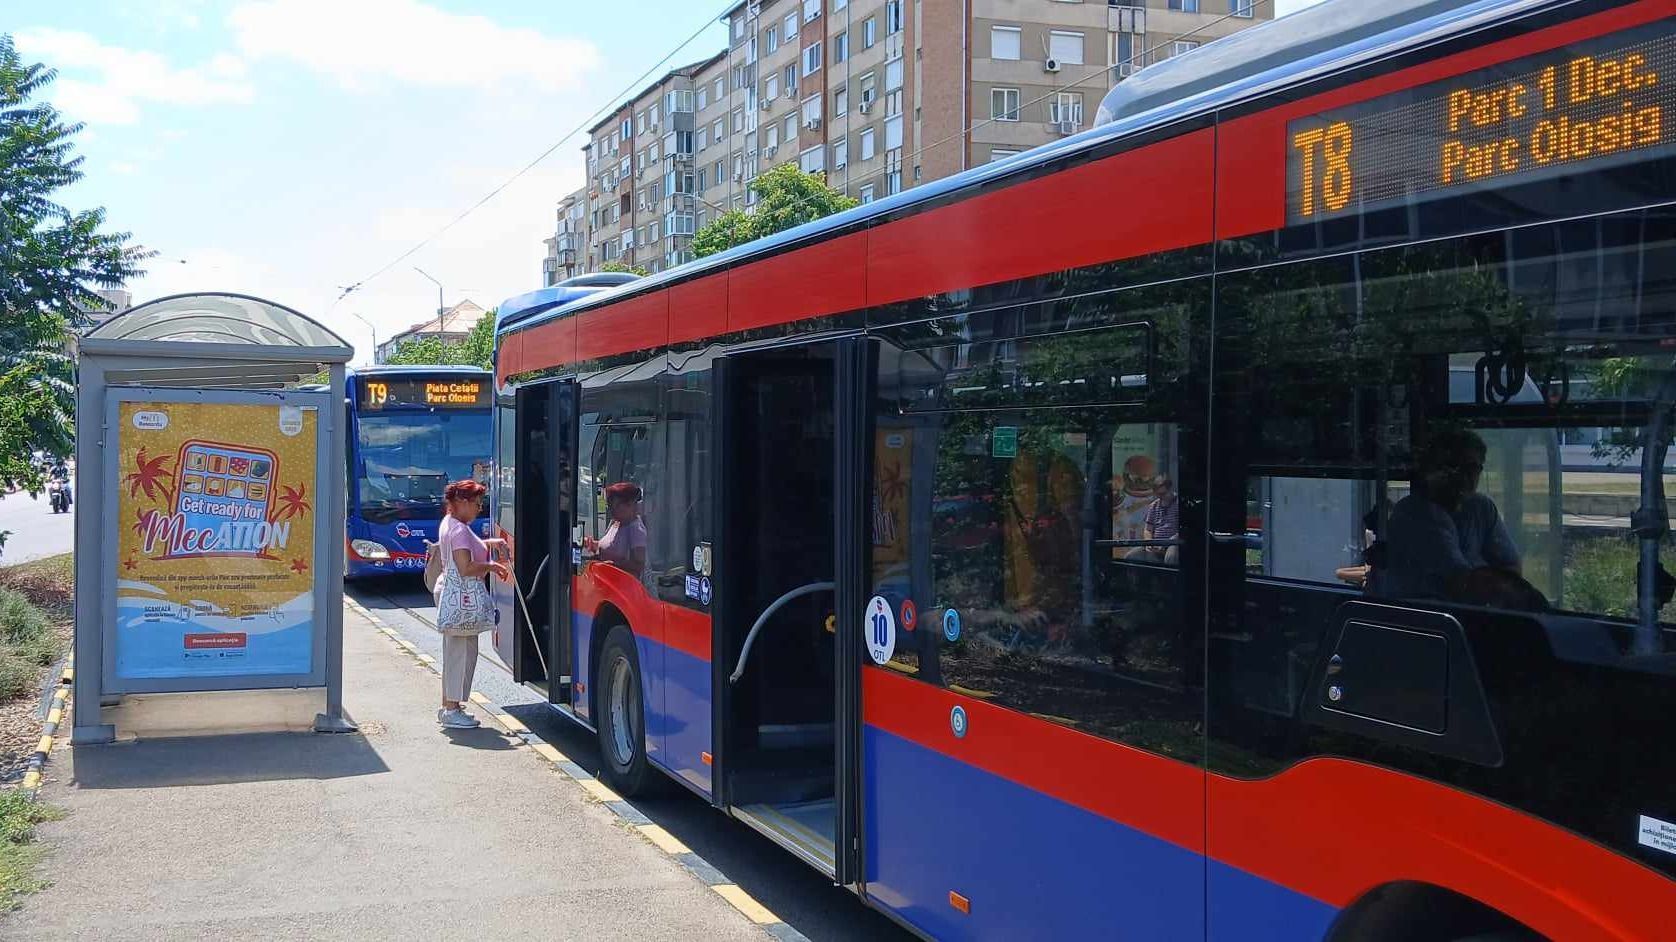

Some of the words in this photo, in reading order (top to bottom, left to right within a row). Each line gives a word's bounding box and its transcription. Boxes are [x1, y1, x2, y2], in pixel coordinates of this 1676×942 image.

[1449, 82, 1526, 132] Parc
[1538, 66, 1554, 108] 1
[1570, 54, 1658, 105] Dec.
[1441, 136, 1519, 184] Parc
[1531, 102, 1660, 162] Olosig
[1294, 121, 1353, 216] T8
[368, 383, 388, 403] T9
[426, 383, 448, 393] Piata
[427, 393, 447, 403] Parc
[181, 496, 205, 514] Get
[206, 501, 243, 521] ready
[243, 503, 264, 520] for
[872, 614, 887, 647] 10
[874, 650, 885, 661] OTL
